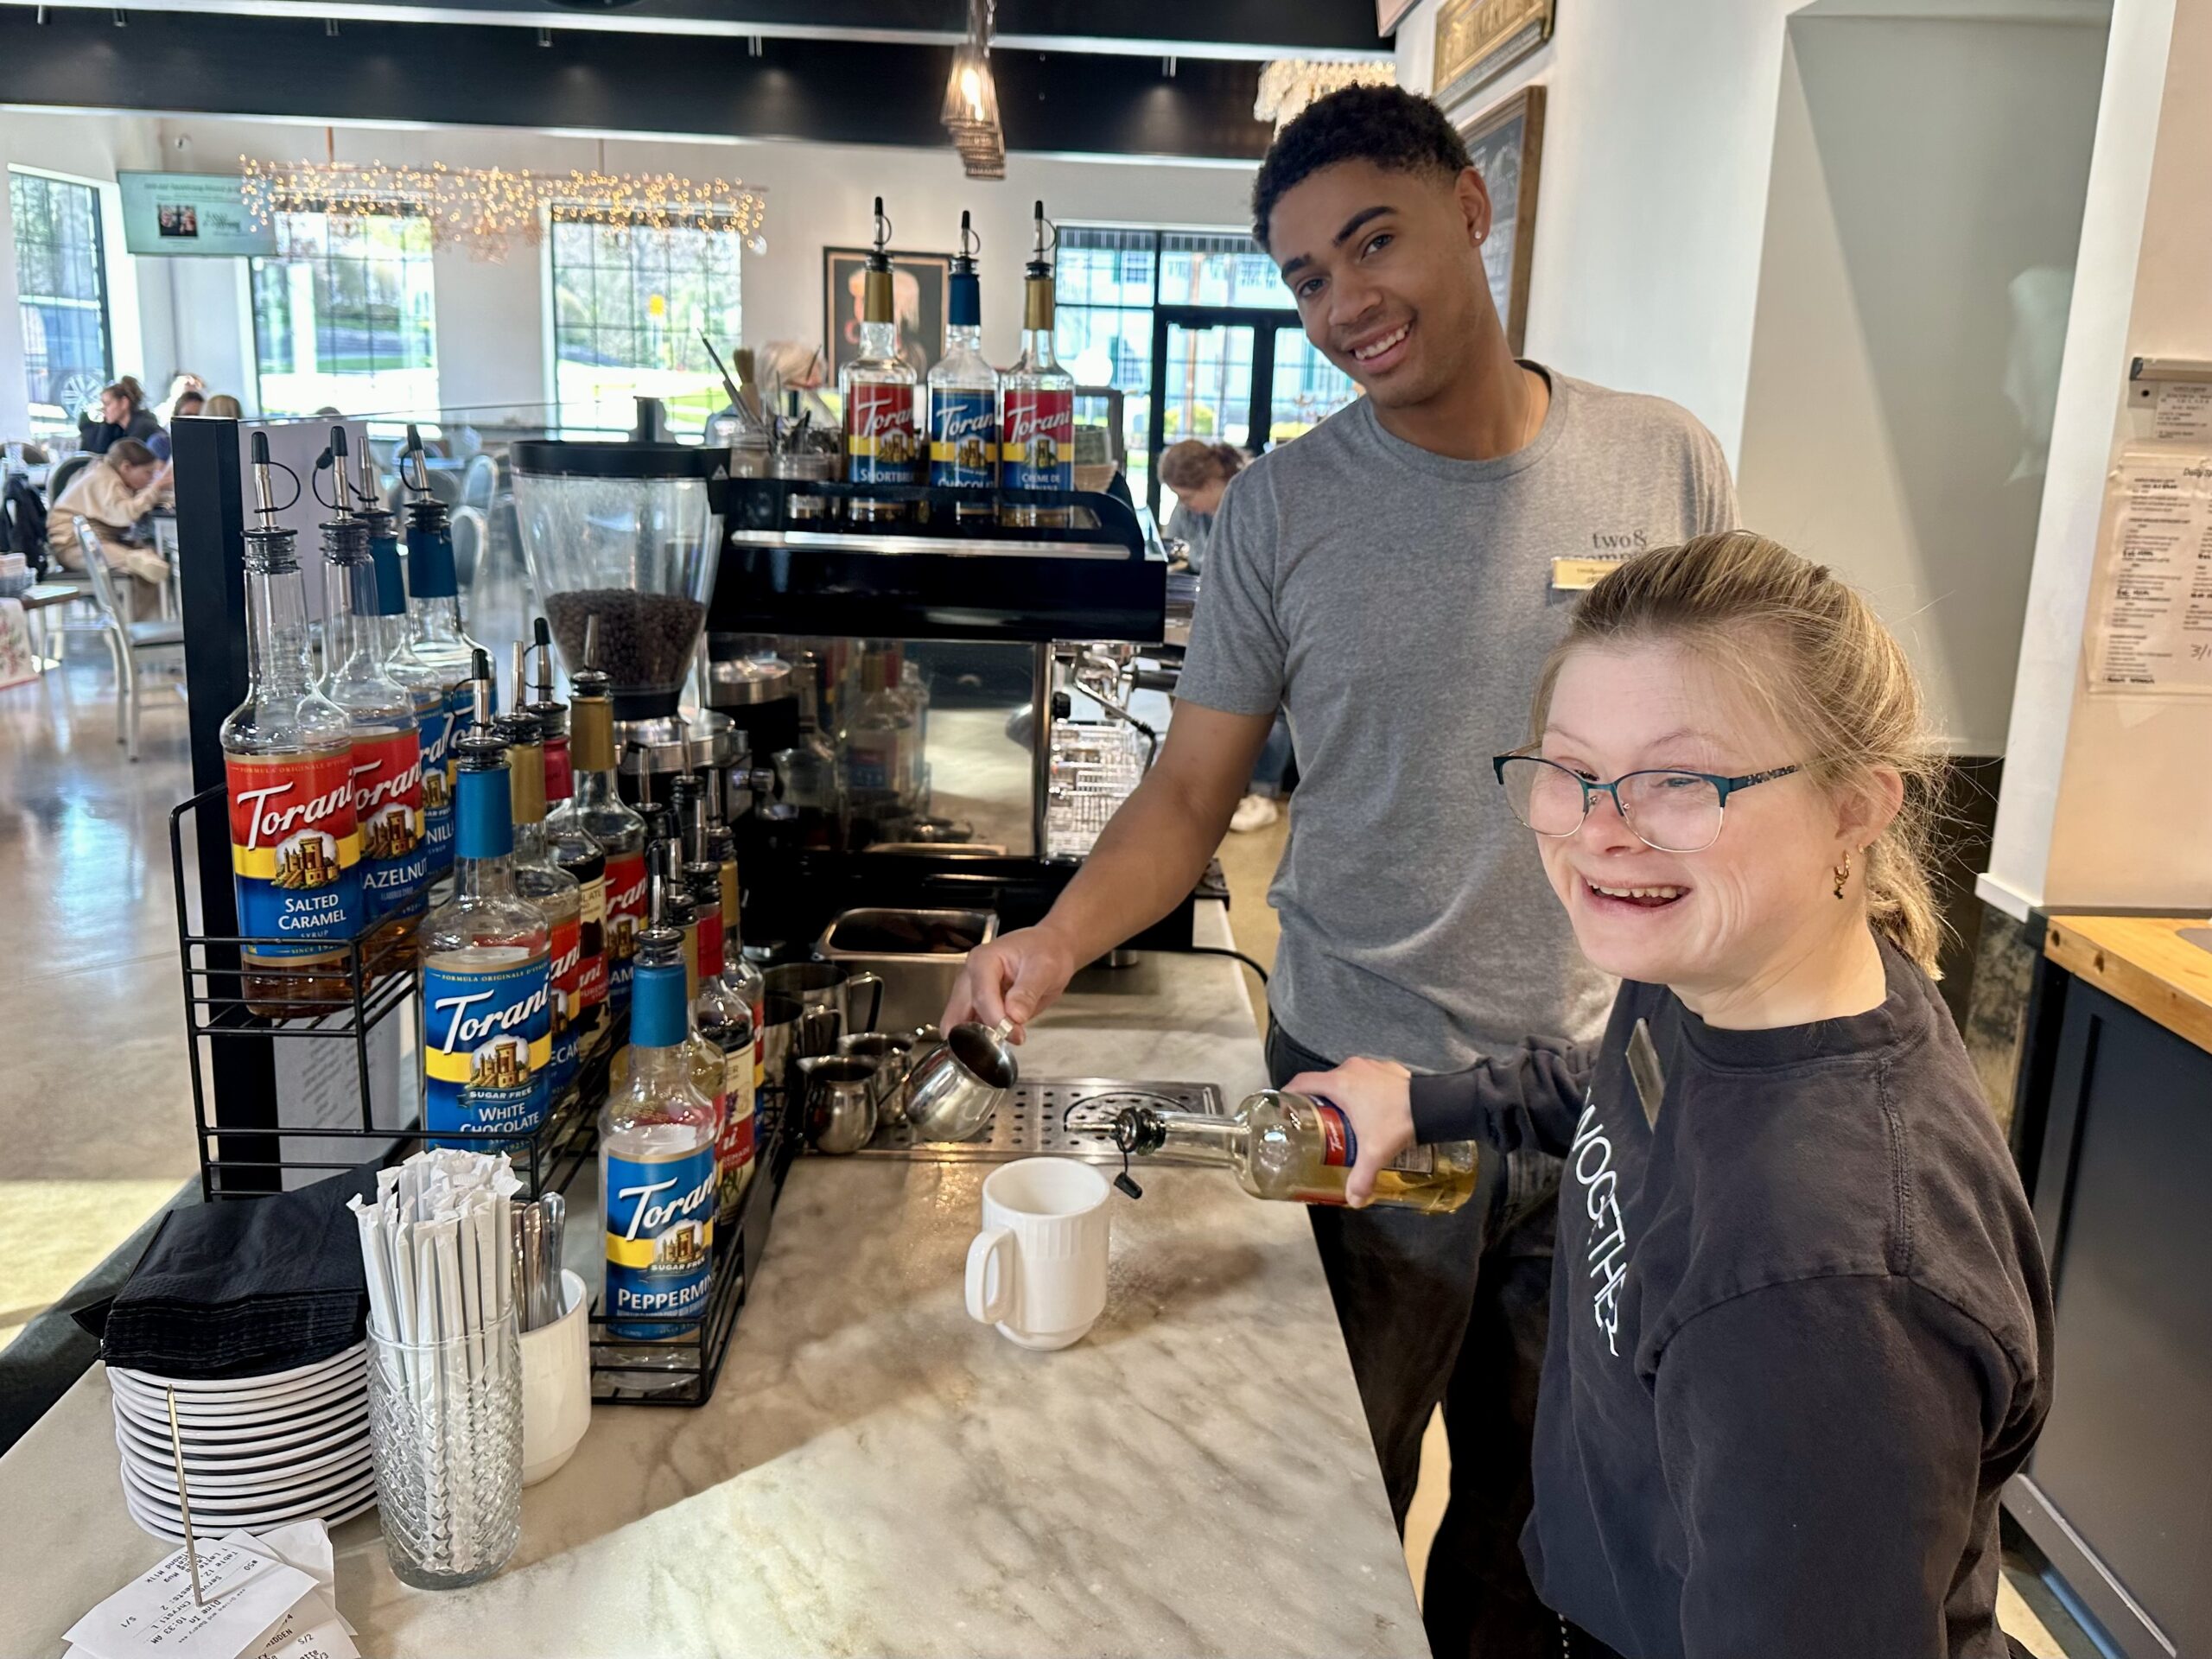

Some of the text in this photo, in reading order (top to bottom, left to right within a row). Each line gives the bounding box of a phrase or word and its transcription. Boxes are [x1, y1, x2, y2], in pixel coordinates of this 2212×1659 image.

[858, 397, 913, 439] Toran
[936, 404, 994, 443] Toran
[1007, 404, 1071, 443] Torani
[237, 768, 353, 851] Torani
[426, 819, 454, 844] NILL
[360, 857, 427, 889] AZELNUT
[285, 894, 339, 913] SALTED
[278, 910, 346, 931] CARAMEL
[442, 974, 478, 982] FORMULA
[481, 970, 524, 982] ORIGINALE
[435, 975, 550, 1056] Torani
[469, 1086, 532, 1100] SUGAR FREE
[460, 1111, 540, 1132] CHOCOLATE
[478, 1103, 526, 1122] WHITE
[618, 1172, 715, 1242] Toran
[618, 1274, 713, 1310] PEPPERMIN
[198, 1552, 221, 1569] Latte
[214, 1551, 238, 1567] Table
[145, 1570, 165, 1584] Milk
[191, 1575, 222, 1597] Serve
[168, 1584, 194, 1603] uests:
[120, 1616, 137, 1628] S/1
[188, 1599, 221, 1624] Dine In
[150, 1616, 188, 1644] 10:33 AM
[297, 1633, 314, 1645] S/2
